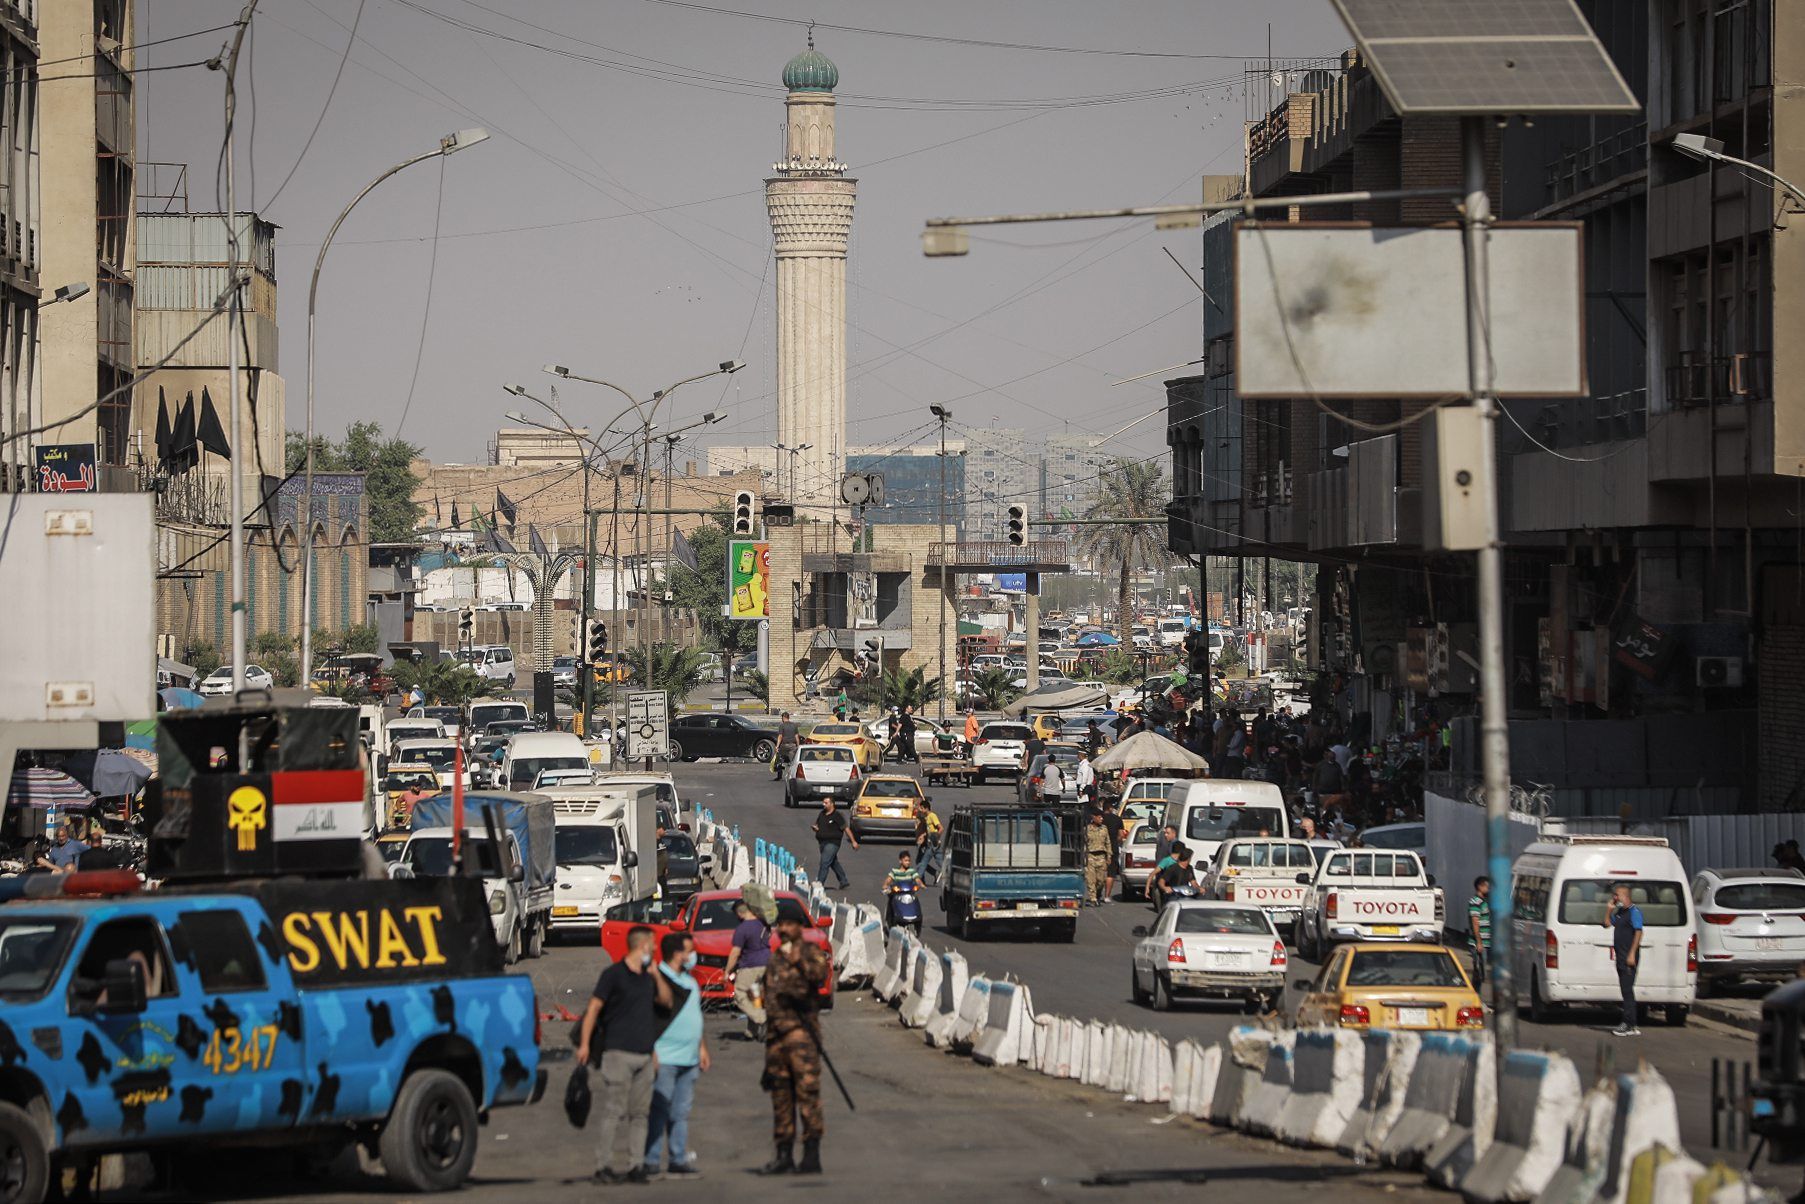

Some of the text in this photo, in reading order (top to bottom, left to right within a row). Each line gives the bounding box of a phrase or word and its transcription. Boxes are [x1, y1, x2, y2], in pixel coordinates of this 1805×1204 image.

[1246, 888, 1304, 900] TOYOT
[1352, 901, 1420, 915] TOYOTA
[282, 905, 448, 973] SWAT
[203, 1023, 280, 1076] 4347
